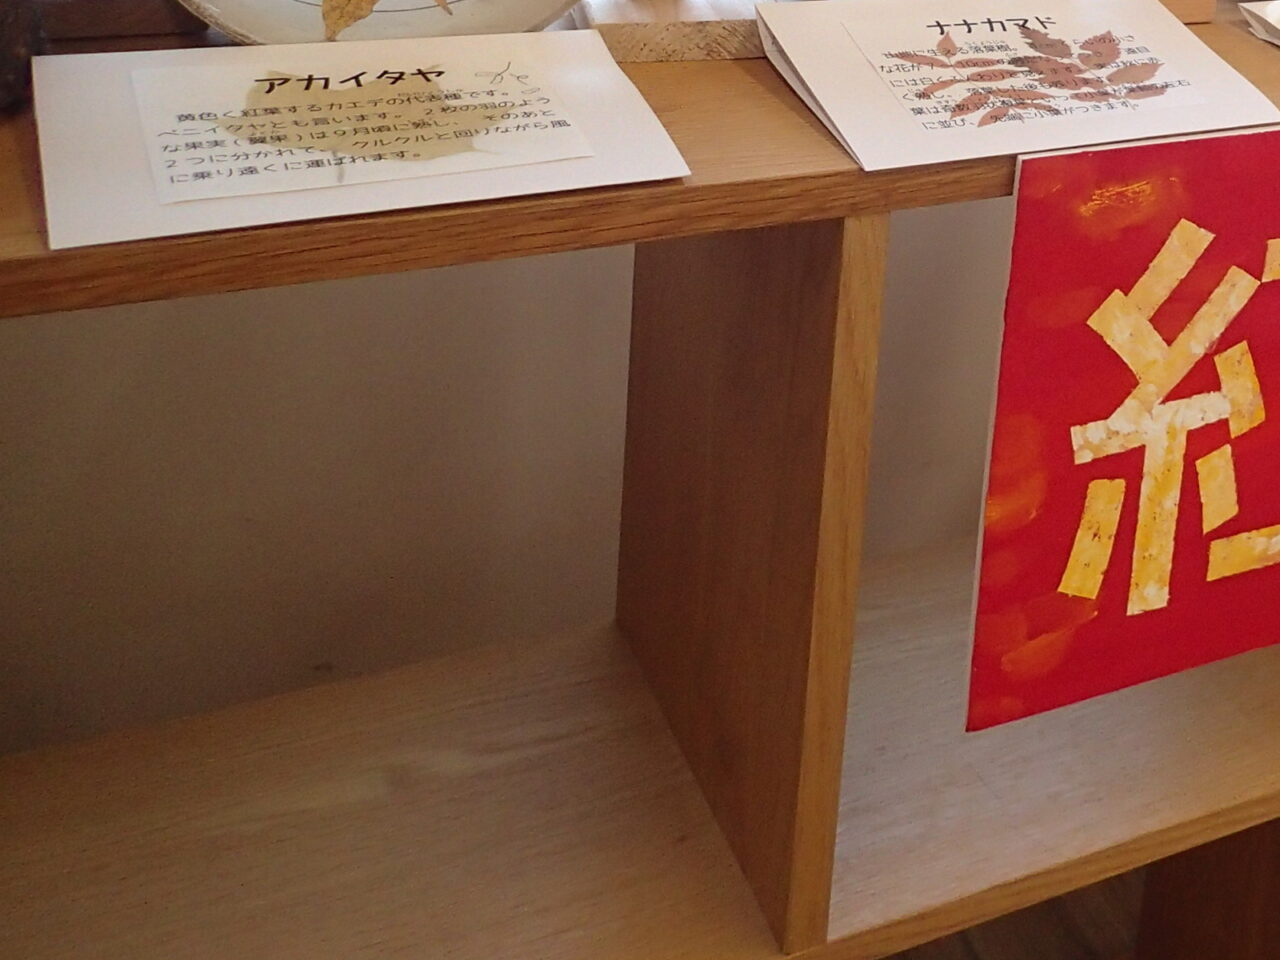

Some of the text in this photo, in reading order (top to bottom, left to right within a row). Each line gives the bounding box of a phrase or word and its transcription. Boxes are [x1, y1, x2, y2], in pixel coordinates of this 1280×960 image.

[926, 16, 1057, 36] ナナカマド
[254, 68, 445, 94] アカイタヤ
